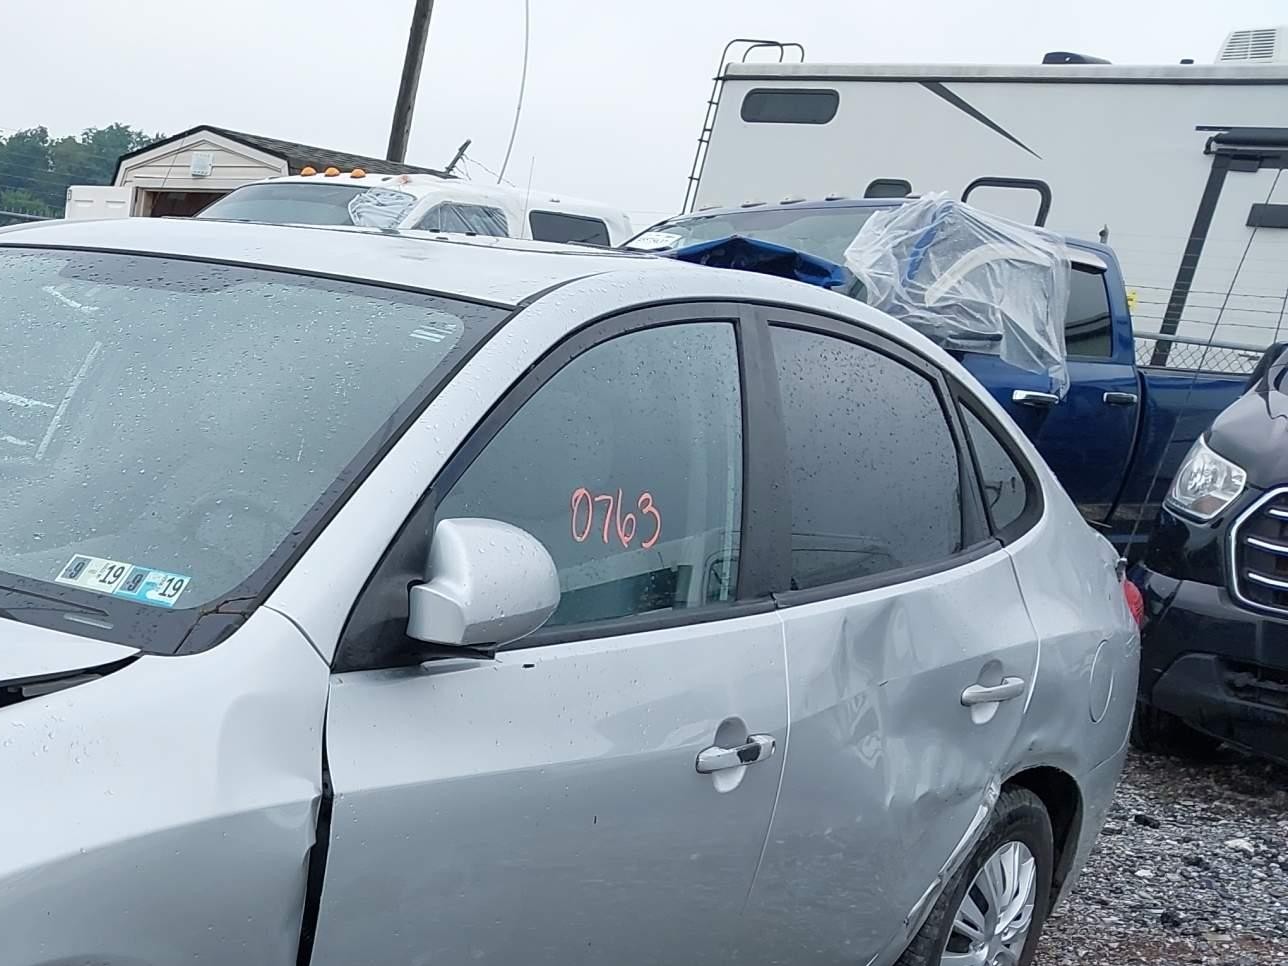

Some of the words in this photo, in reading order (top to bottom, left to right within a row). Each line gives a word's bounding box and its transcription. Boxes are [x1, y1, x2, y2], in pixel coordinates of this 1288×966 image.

[571, 487, 661, 549] 0763
[98, 564, 125, 585] 19
[158, 577, 185, 598] 19
